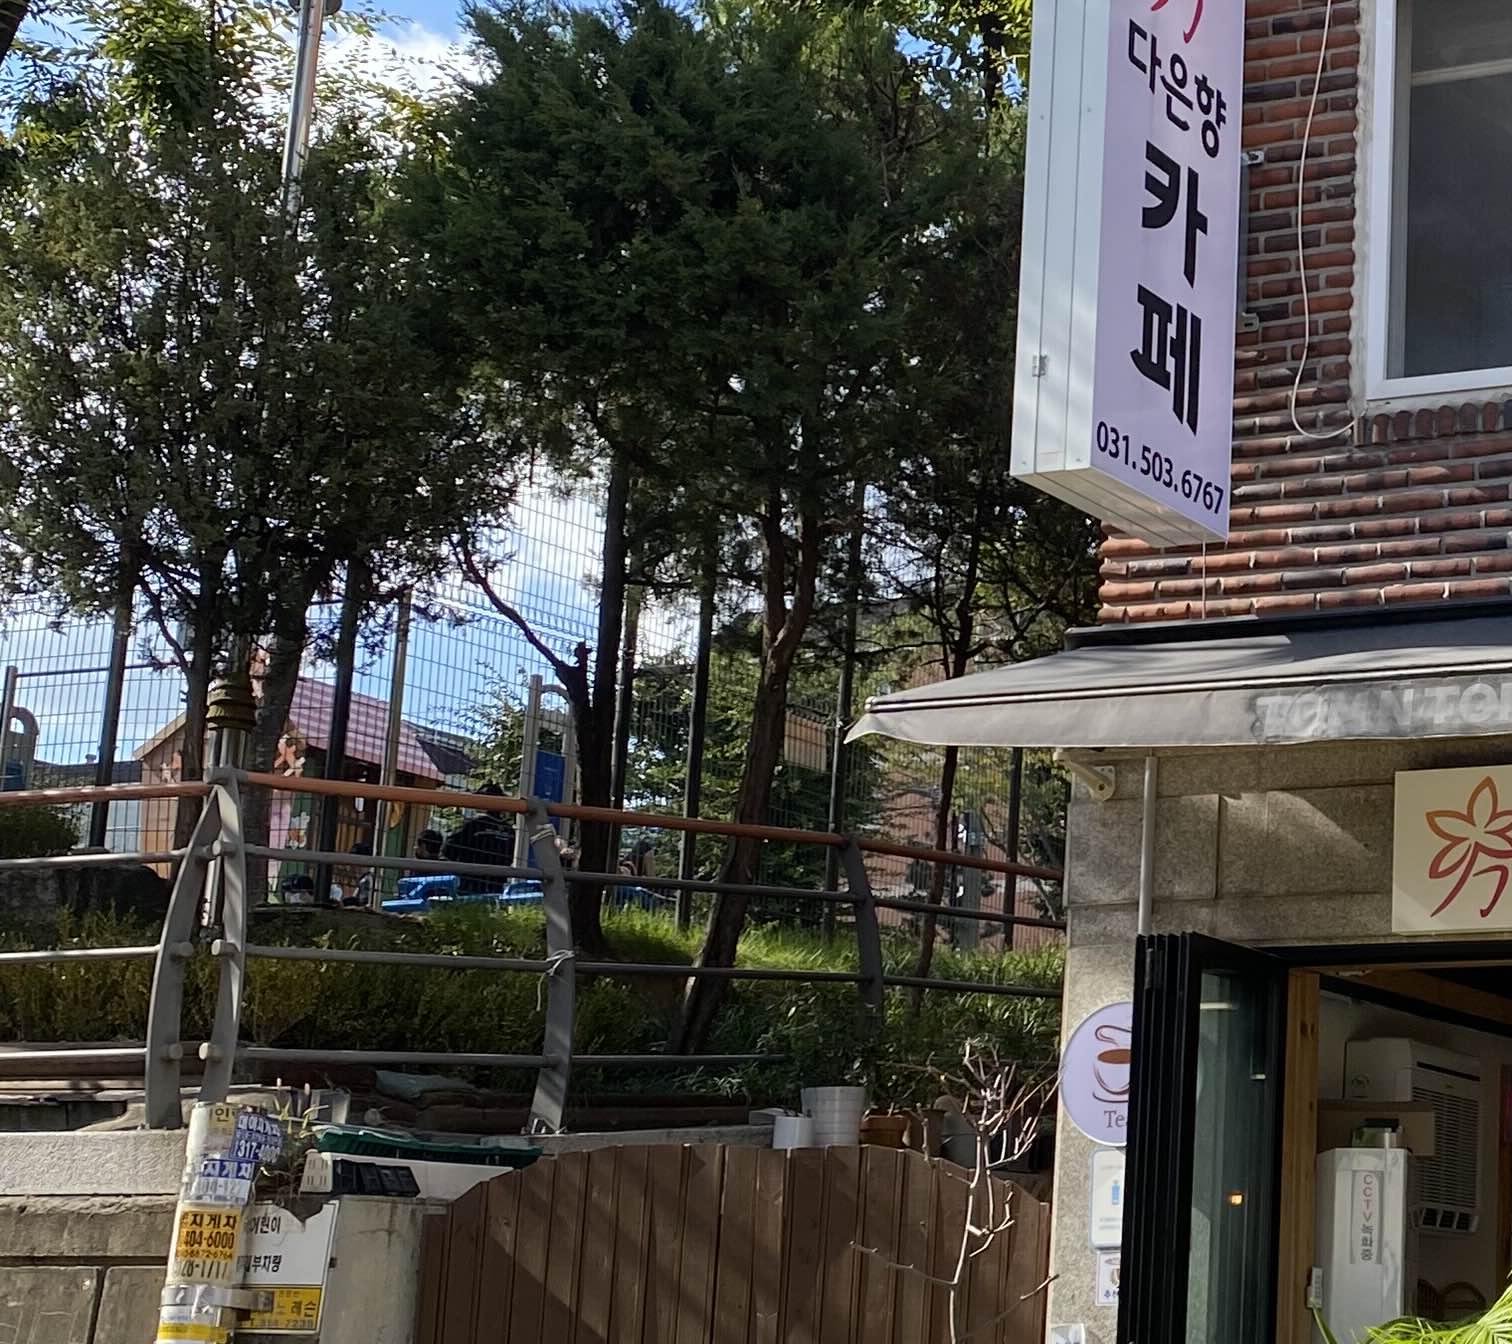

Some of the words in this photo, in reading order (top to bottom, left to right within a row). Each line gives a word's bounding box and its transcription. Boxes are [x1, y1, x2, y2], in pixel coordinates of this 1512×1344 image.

[1127, 18, 1227, 159] 다은향
[1130, 140, 1208, 438] 카페
[1096, 420, 1224, 515] 031.503.6767
[1103, 1110, 1128, 1128] Te
